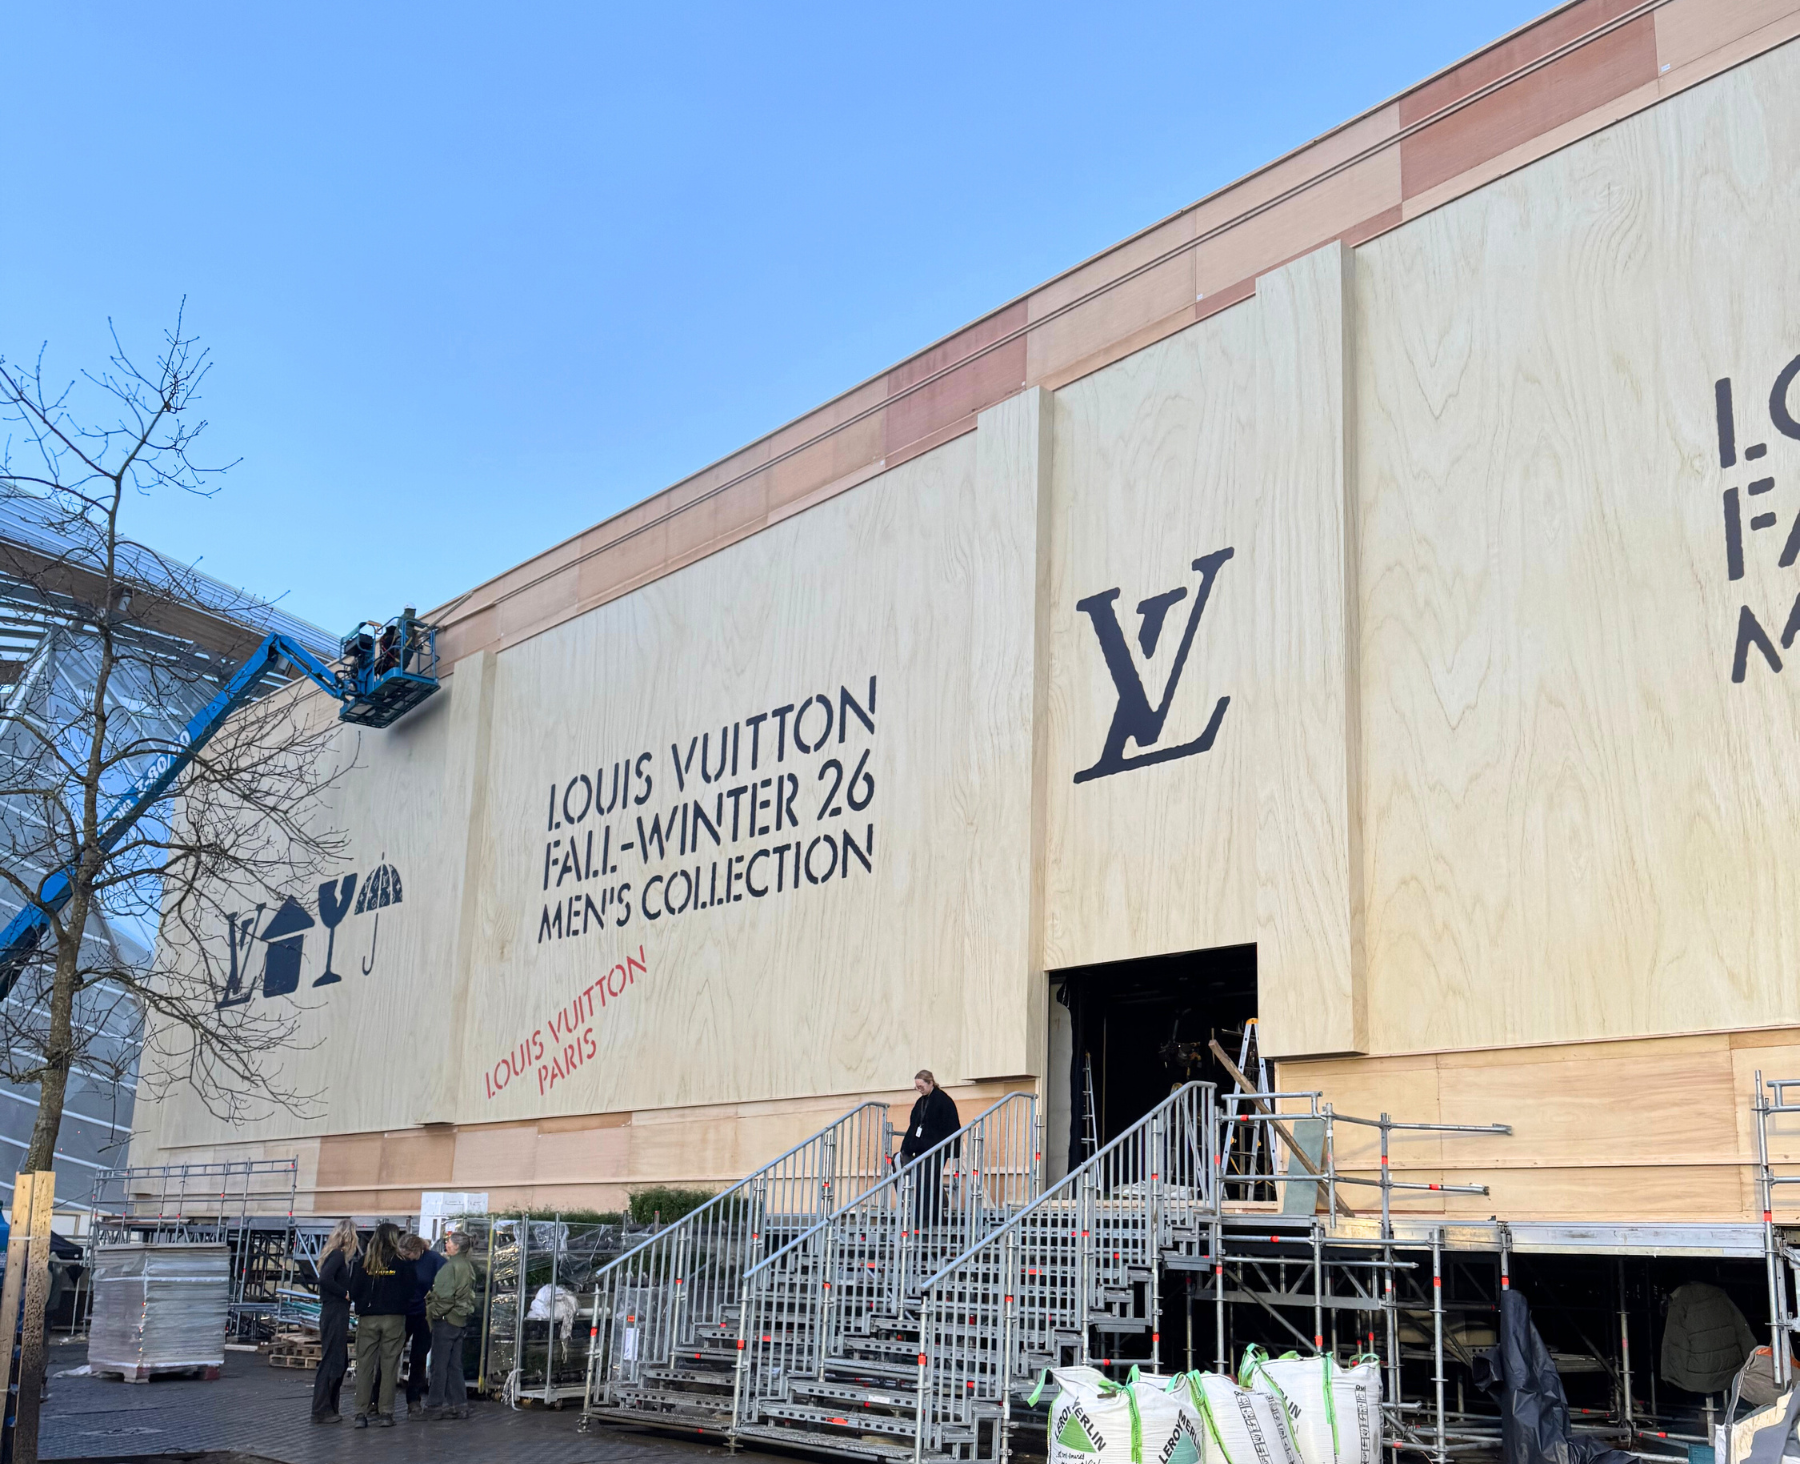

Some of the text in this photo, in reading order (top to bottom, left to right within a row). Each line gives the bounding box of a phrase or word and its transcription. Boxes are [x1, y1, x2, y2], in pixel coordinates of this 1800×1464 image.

[543, 748, 875, 890] FALL-WINTER 26
[547, 675, 876, 831] LOUIS VUITTON
[538, 823, 874, 943] MEN'S COLLECTION
[485, 945, 647, 1099] LOUIS VUITTON
[537, 1028, 597, 1096] PARIS
